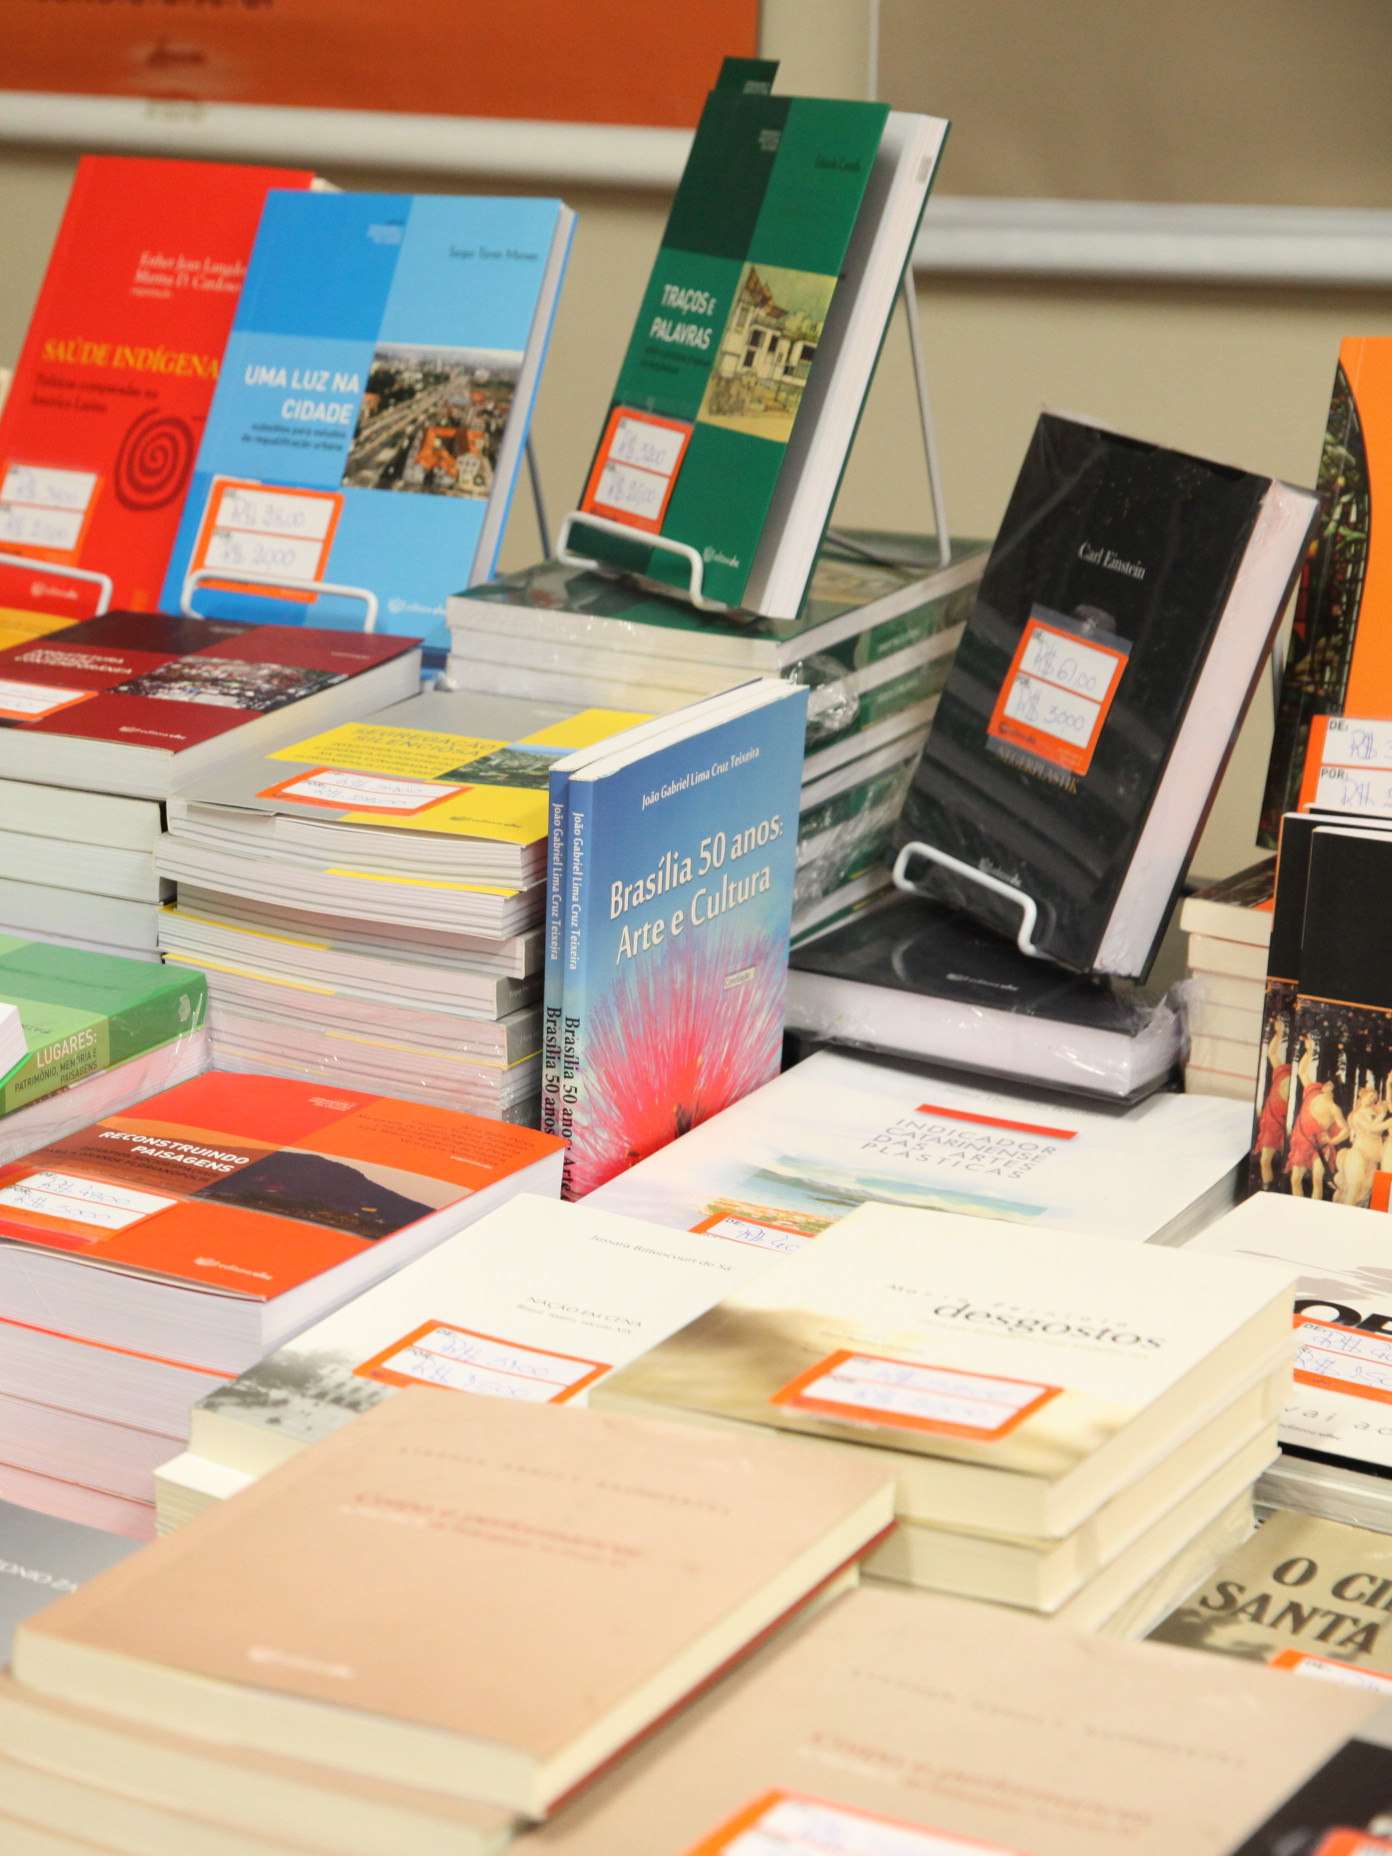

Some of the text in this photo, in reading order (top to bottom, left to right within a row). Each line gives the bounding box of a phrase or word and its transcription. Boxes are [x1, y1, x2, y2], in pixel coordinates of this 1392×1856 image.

[661, 284, 707, 316] TRAÇOS
[649, 317, 713, 351] PALAVRAS
[42, 336, 220, 381] SAÚDE INDÍGENA
[244, 365, 360, 394] UMA LUZ NA
[281, 398, 354, 424] CIDADE
[1078, 541, 1146, 581] Carl Einstein
[642, 747, 760, 812] João Gabriel Lima Cruz Teixeira
[550, 803, 564, 961] João Gabriel Lima Cruz Teixeira
[610, 814, 784, 920] Brasília 50 anos:
[569, 811, 585, 970] João Gabriel Lima Cruz Teixeira
[616, 865, 772, 965] Arte e Cultura
[36, 1028, 98, 1068] LUGARES:
[545, 1006, 562, 1070] Brasília
[14, 1048, 97, 1093] PATRIMÔNIO, MEMÓRIA E
[60, 1060, 98, 1083] PAISAGENS
[544, 1073, 560, 1095] 50
[561, 1016, 581, 1192] Brasília 50 Arte
[99, 1131, 250, 1165] RECONSTRUINDO
[873, 1134, 1032, 1172] DAS ARTES
[885, 1127, 1048, 1163] CATARINENSE
[894, 1119, 1057, 1155] INDICADOR
[131, 1145, 235, 1173] PAISAGENS
[724, 1217, 746, 1229] DE:
[633, 1244, 698, 1265] Bittencourt
[699, 1257, 715, 1268] de
[527, 1296, 642, 1328] NAÇÃO EM CENA
[932, 1303, 1166, 1350] desgostos
[1272, 1556, 1319, 1588] O
[1198, 1580, 1382, 1656] SANTA
